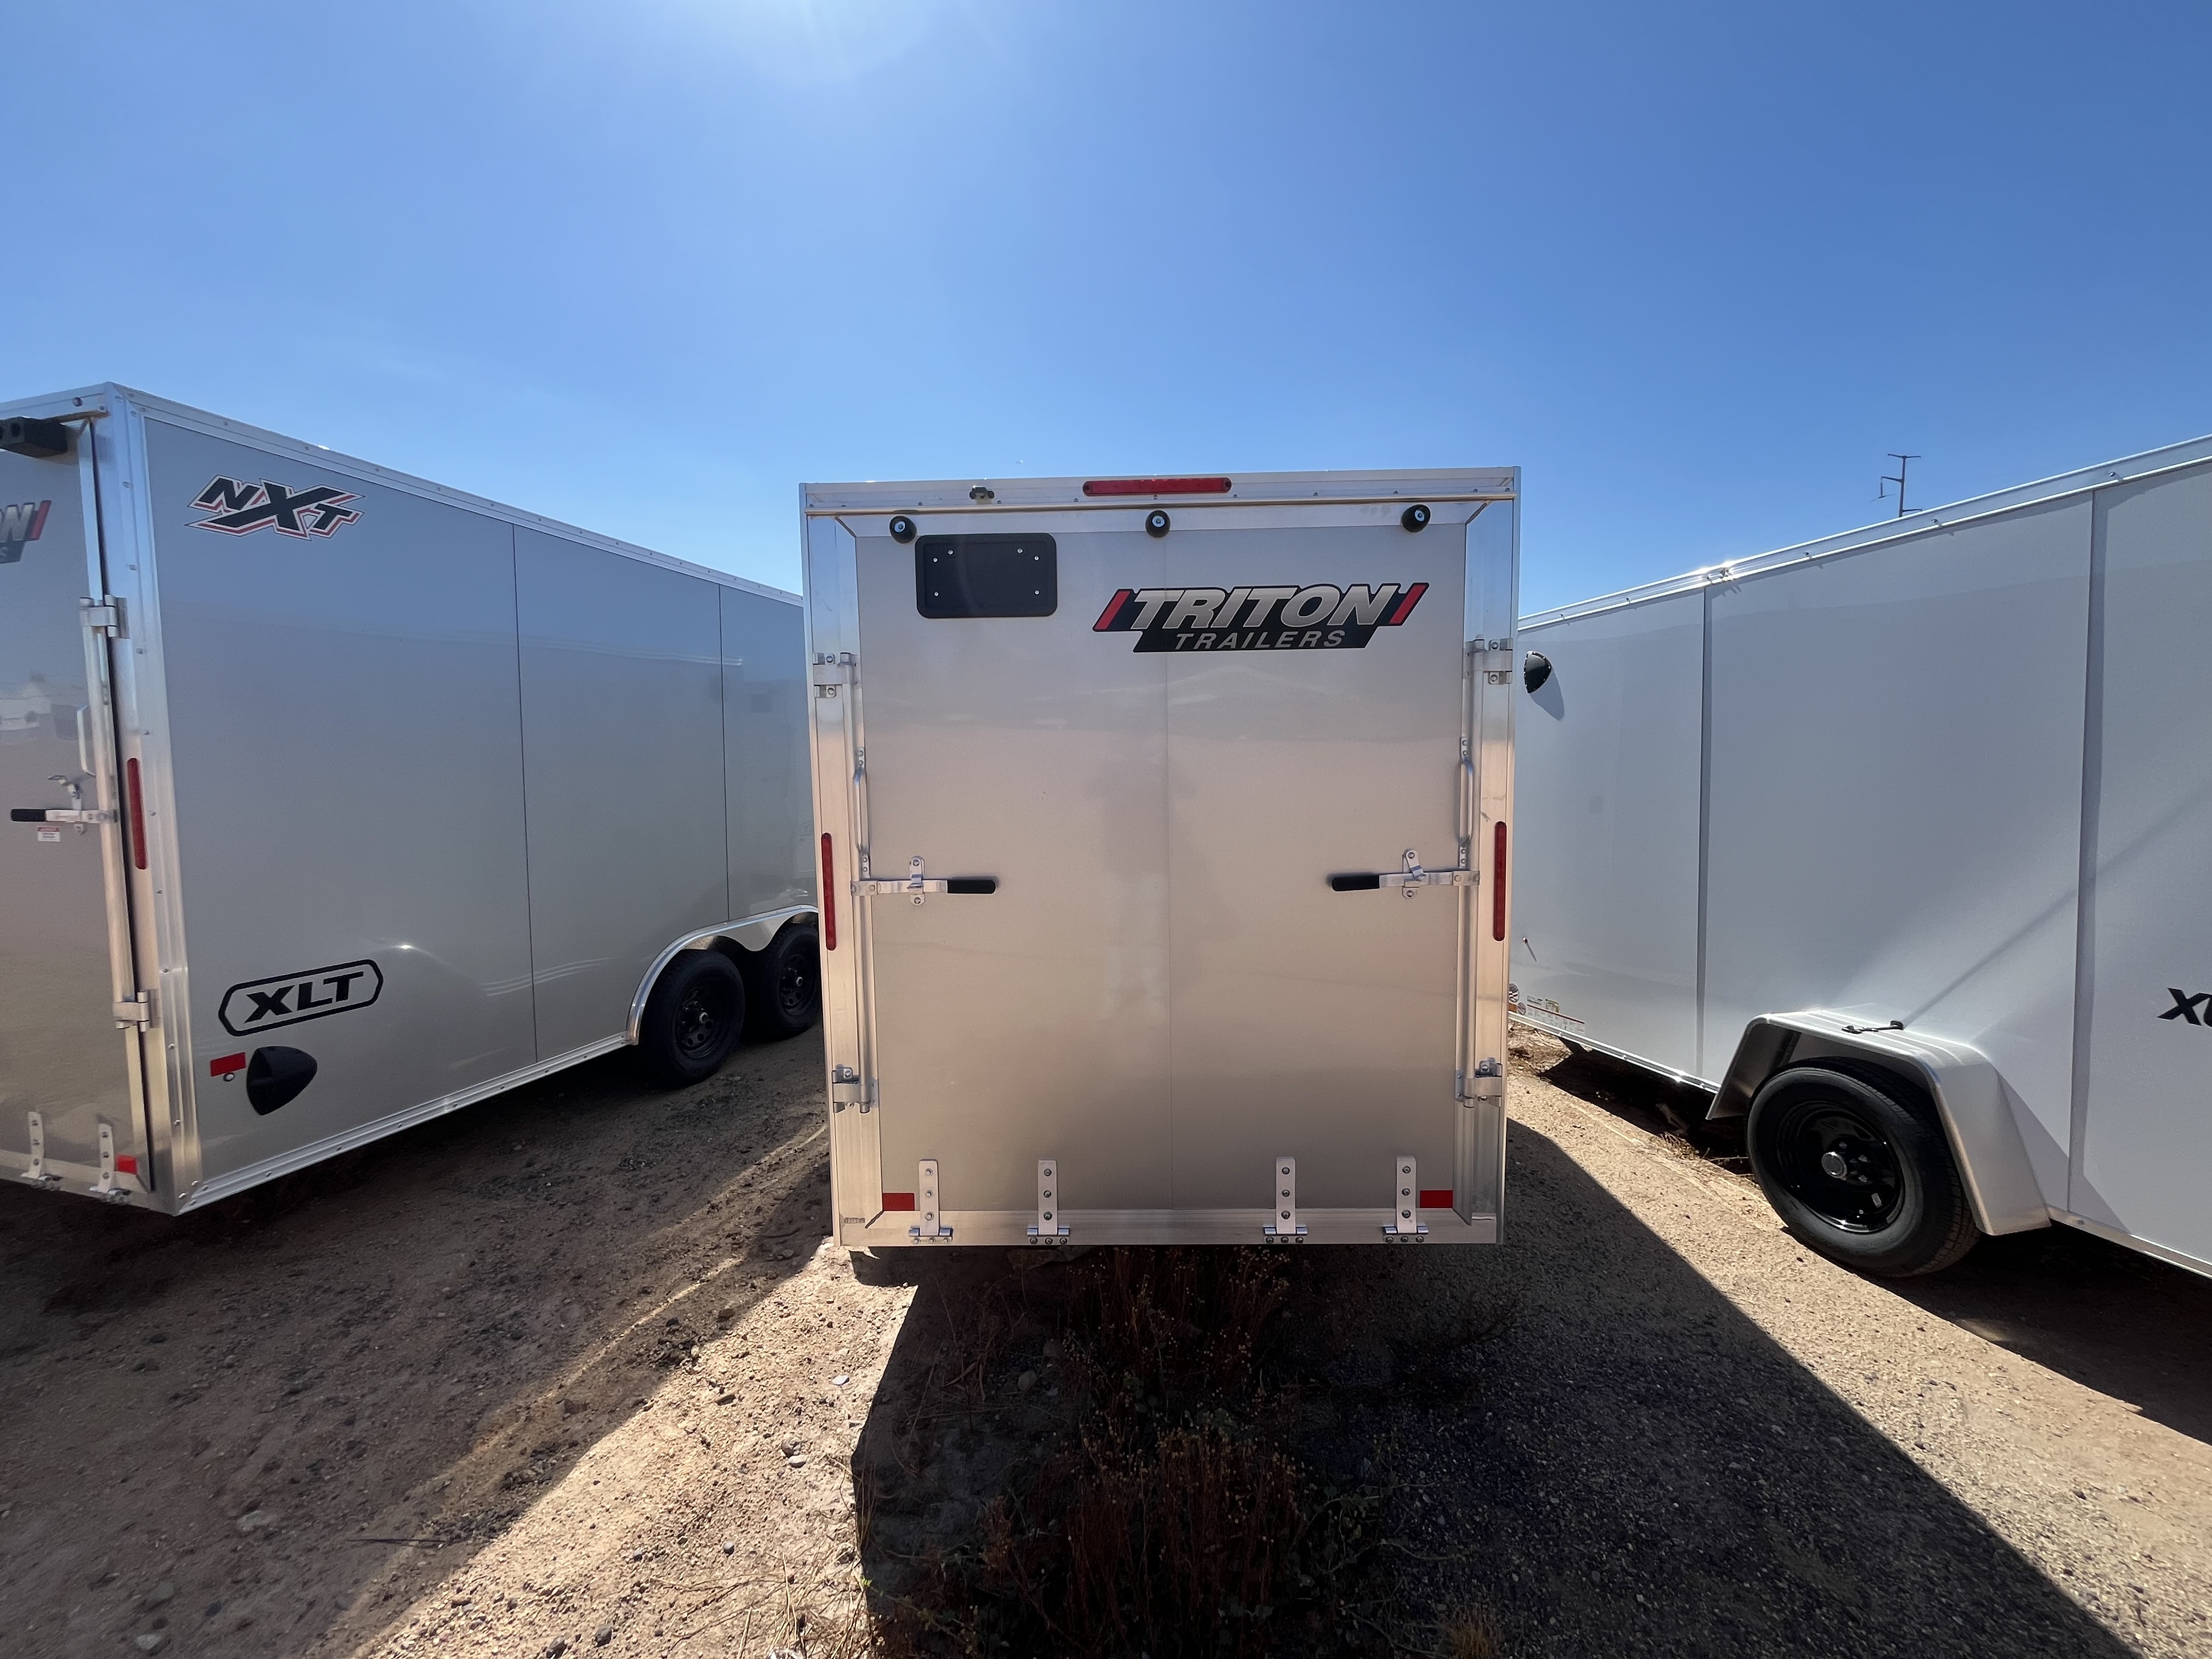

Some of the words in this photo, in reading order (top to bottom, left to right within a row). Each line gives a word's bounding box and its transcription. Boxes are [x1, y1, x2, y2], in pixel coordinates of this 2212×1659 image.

[196, 477, 355, 532] NXT
[1130, 585, 1398, 630] TRITON
[1175, 630, 1346, 650] TRAILERS
[244, 971, 364, 1024] XLT
[2157, 988, 2212, 1027] X
